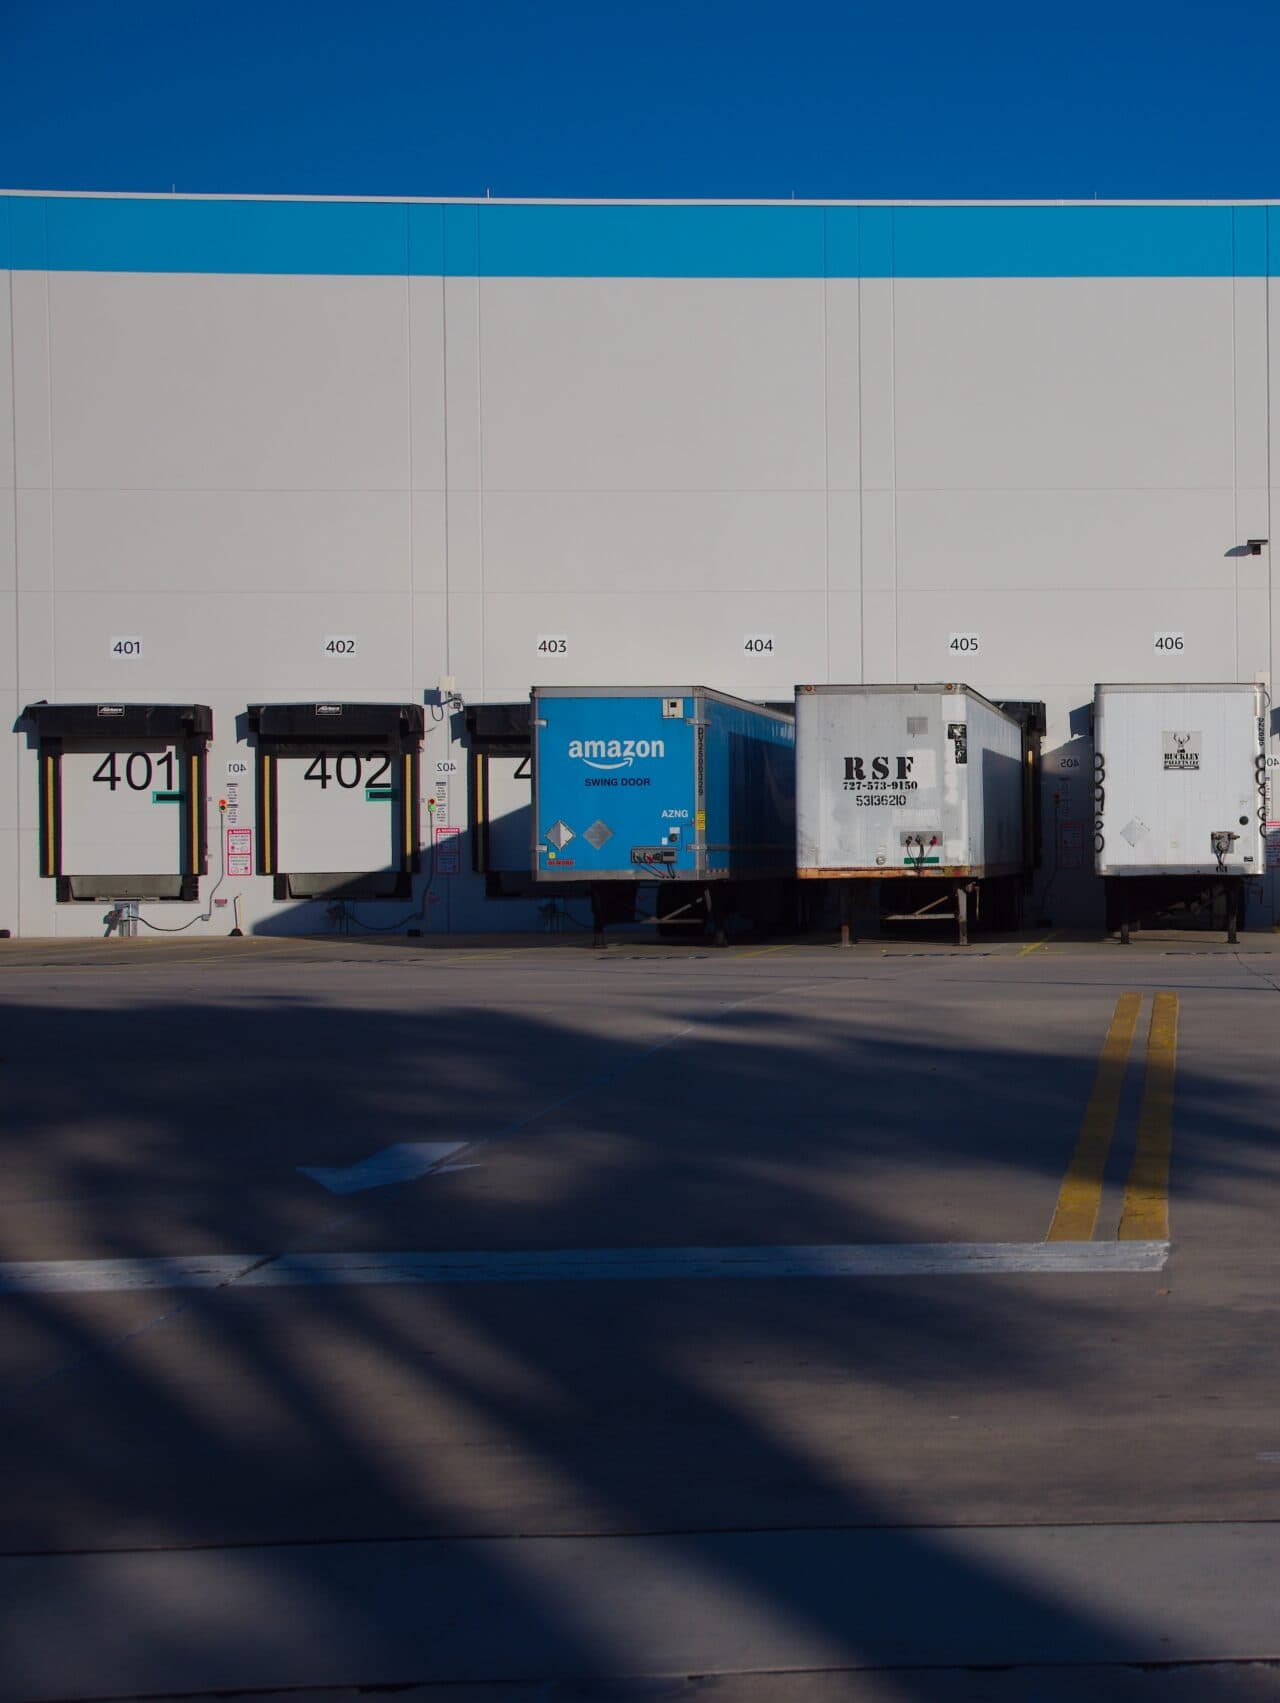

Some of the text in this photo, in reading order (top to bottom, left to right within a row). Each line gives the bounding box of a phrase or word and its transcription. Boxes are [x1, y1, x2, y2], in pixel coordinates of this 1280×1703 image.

[113, 641, 140, 655] 401
[326, 640, 355, 654] 402
[538, 639, 567, 653] 403
[744, 639, 773, 652] 404
[950, 638, 978, 651] 405
[1155, 637, 1184, 650] 406
[568, 737, 664, 761] amazon
[93, 751, 174, 791] 401
[304, 751, 392, 789] 402
[584, 777, 650, 787] SWING DOOR
[843, 781, 918, 791] 727-573-9150
[855, 794, 907, 807] 53136210
[661, 809, 689, 818] AZNG
